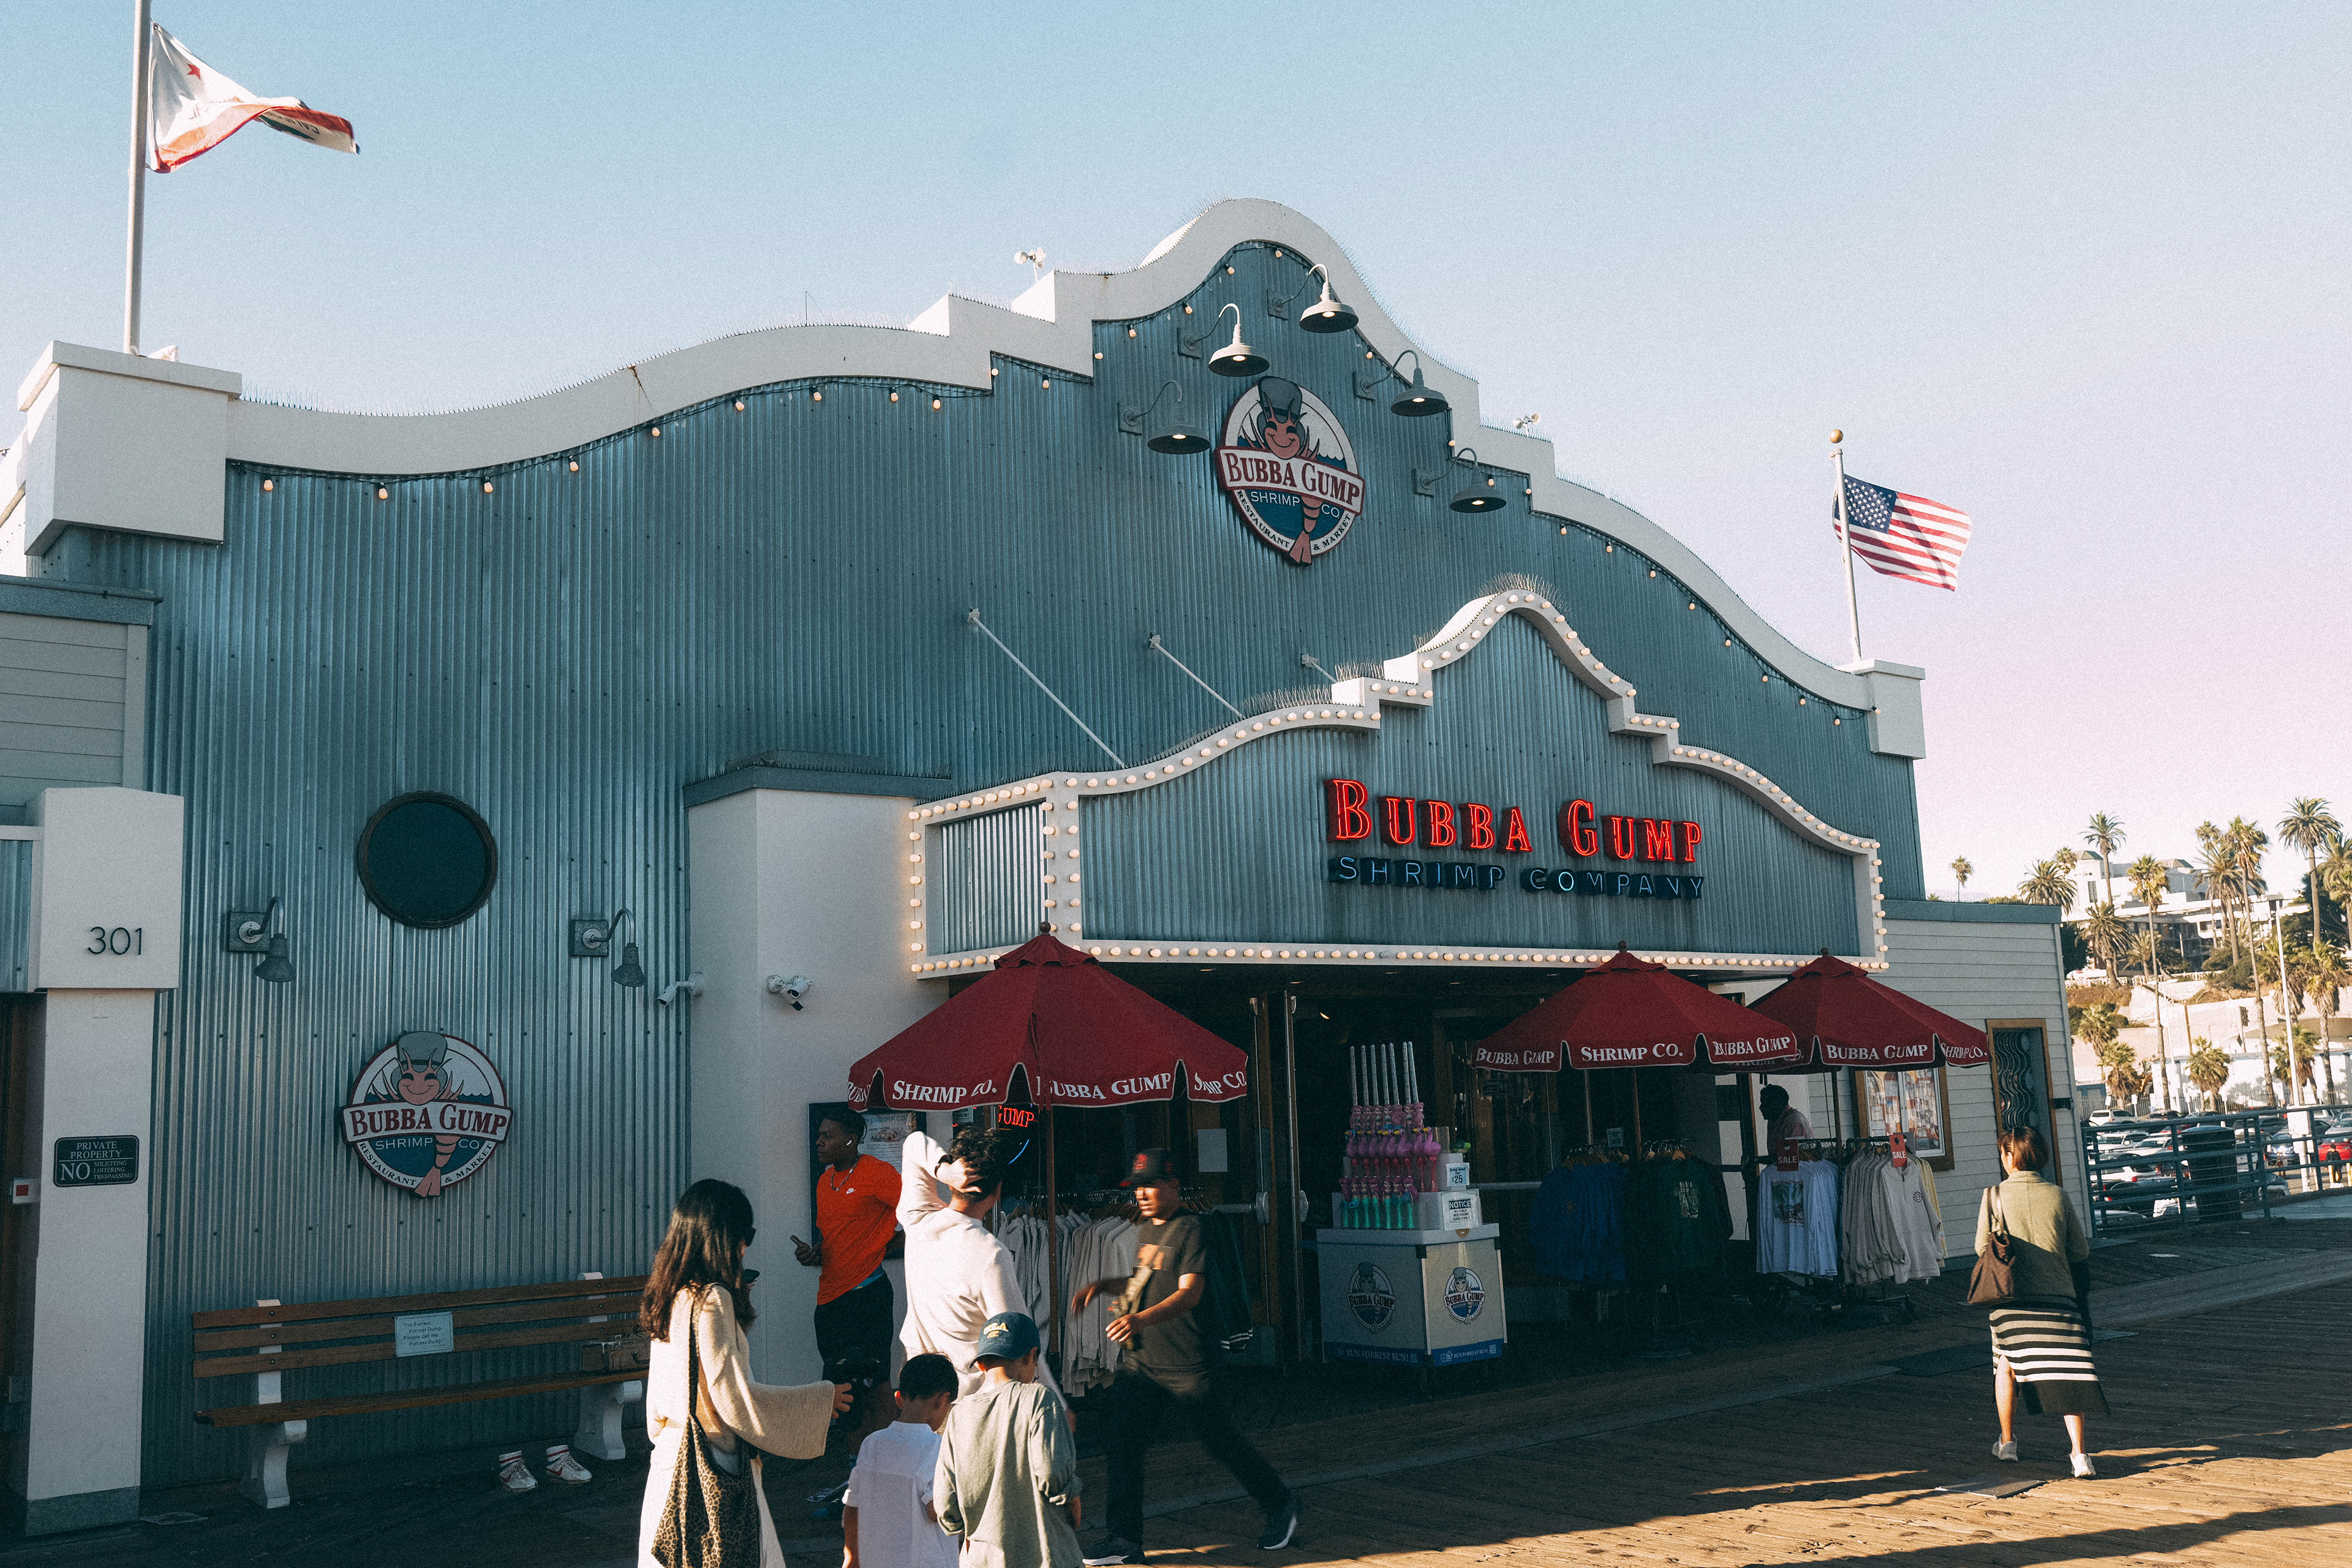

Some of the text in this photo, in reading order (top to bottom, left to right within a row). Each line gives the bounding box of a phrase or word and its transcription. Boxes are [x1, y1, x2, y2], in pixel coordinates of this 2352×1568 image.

[1225, 453, 1360, 505] BUBBA GUMP
[1251, 492, 1340, 519] SHRIMP CO.
[1237, 491, 1290, 548] RESTAURANT
[1322, 514, 1351, 548] MARKET
[1325, 778, 1702, 862] BUBBA GUMP
[1329, 857, 1705, 898] SHRIMP COMPANY
[88, 927, 143, 956] 301
[1476, 1048, 1518, 1065] BUBBA
[1581, 1043, 1683, 1062] SHRIMP CO.
[1826, 1044, 1928, 1060] BUBBA GUMP
[892, 1080, 967, 1103] SHRIMP
[1111, 1073, 1171, 1096] GUMP
[350, 1104, 507, 1136] BUBBA GUMP
[77, 1141, 117, 1150] PRIVATE
[375, 1137, 480, 1150] SHRIMP CO.
[70, 1150, 121, 1159] PROPERTY
[360, 1142, 417, 1185] RESTAURANT
[456, 1144, 492, 1178] MARKET
[60, 1163, 91, 1181] NO
[1348, 1294, 1395, 1308] BUBBA GUMP
[1445, 1291, 1484, 1306] BUBBA GUMP
[1347, 1349, 1409, 1362] RUN FORREST RUN!
